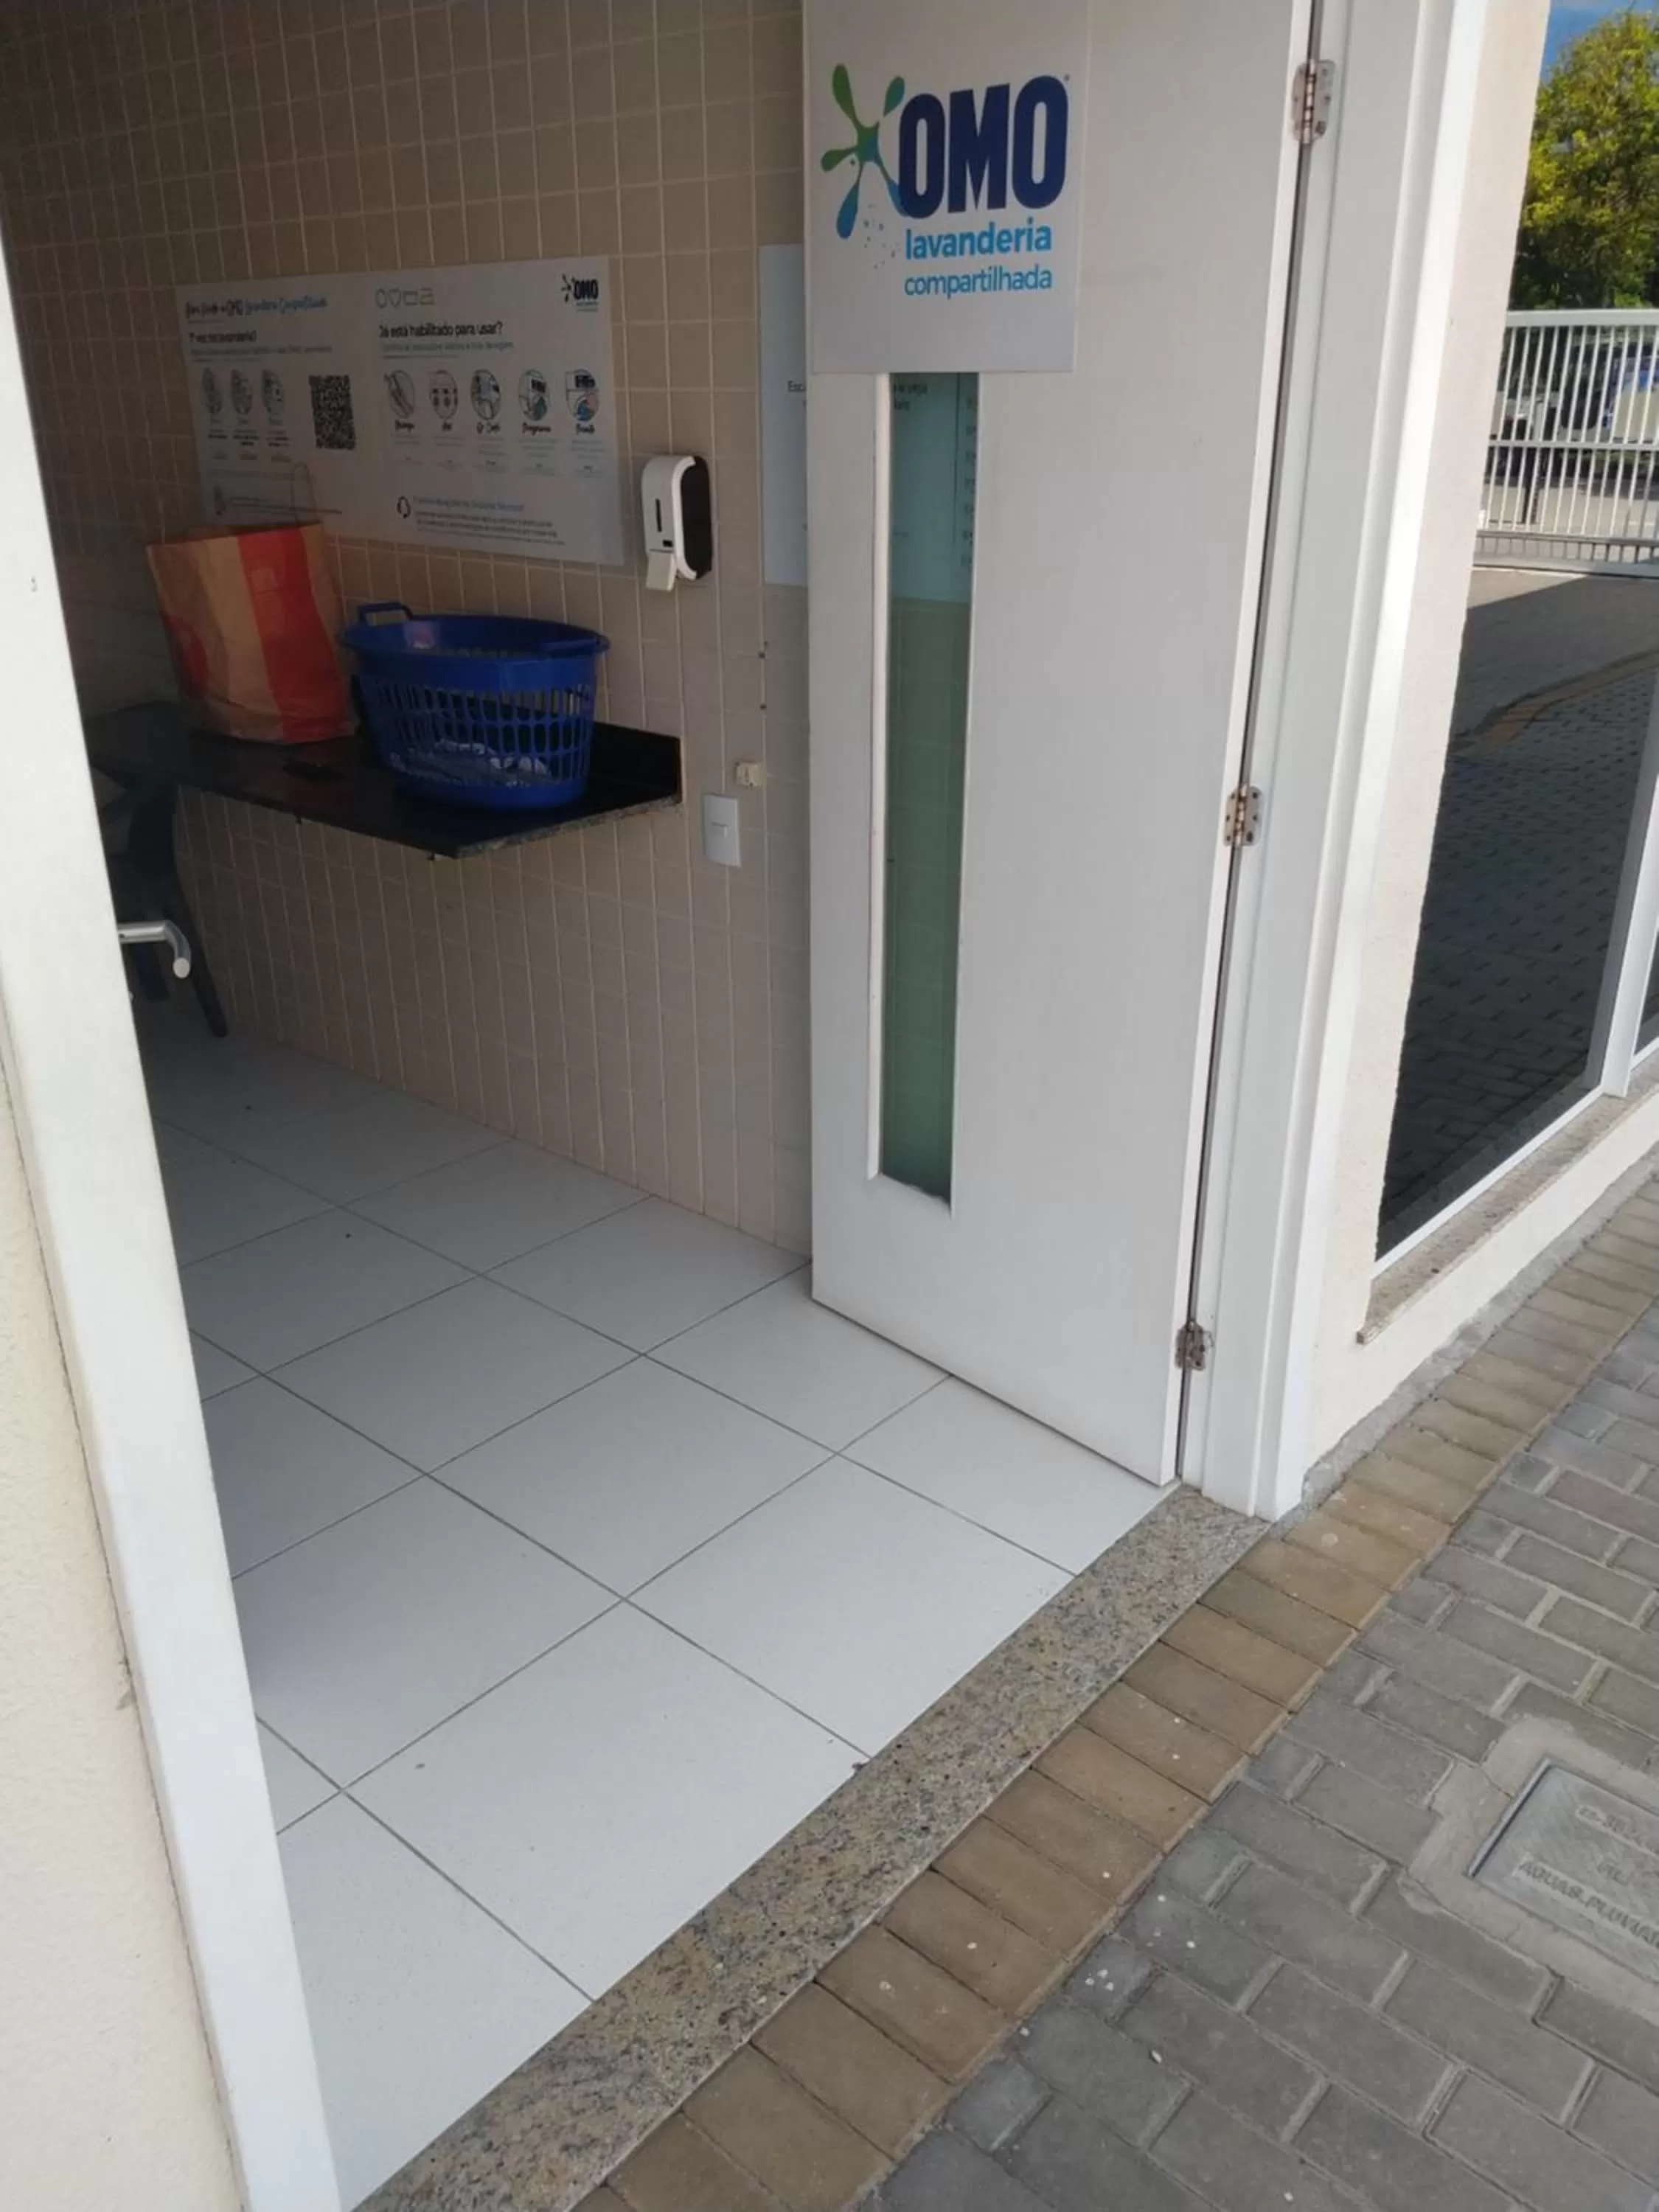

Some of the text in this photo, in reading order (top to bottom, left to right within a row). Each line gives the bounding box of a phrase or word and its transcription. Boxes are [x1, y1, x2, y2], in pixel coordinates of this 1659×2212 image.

[899, 75, 1068, 219] OMO
[905, 218, 1052, 260] lavanderia
[574, 279, 599, 300] OMO
[904, 264, 1053, 299] compartilhada
[410, 321, 453, 336] habilitado
[455, 324, 476, 336] para
